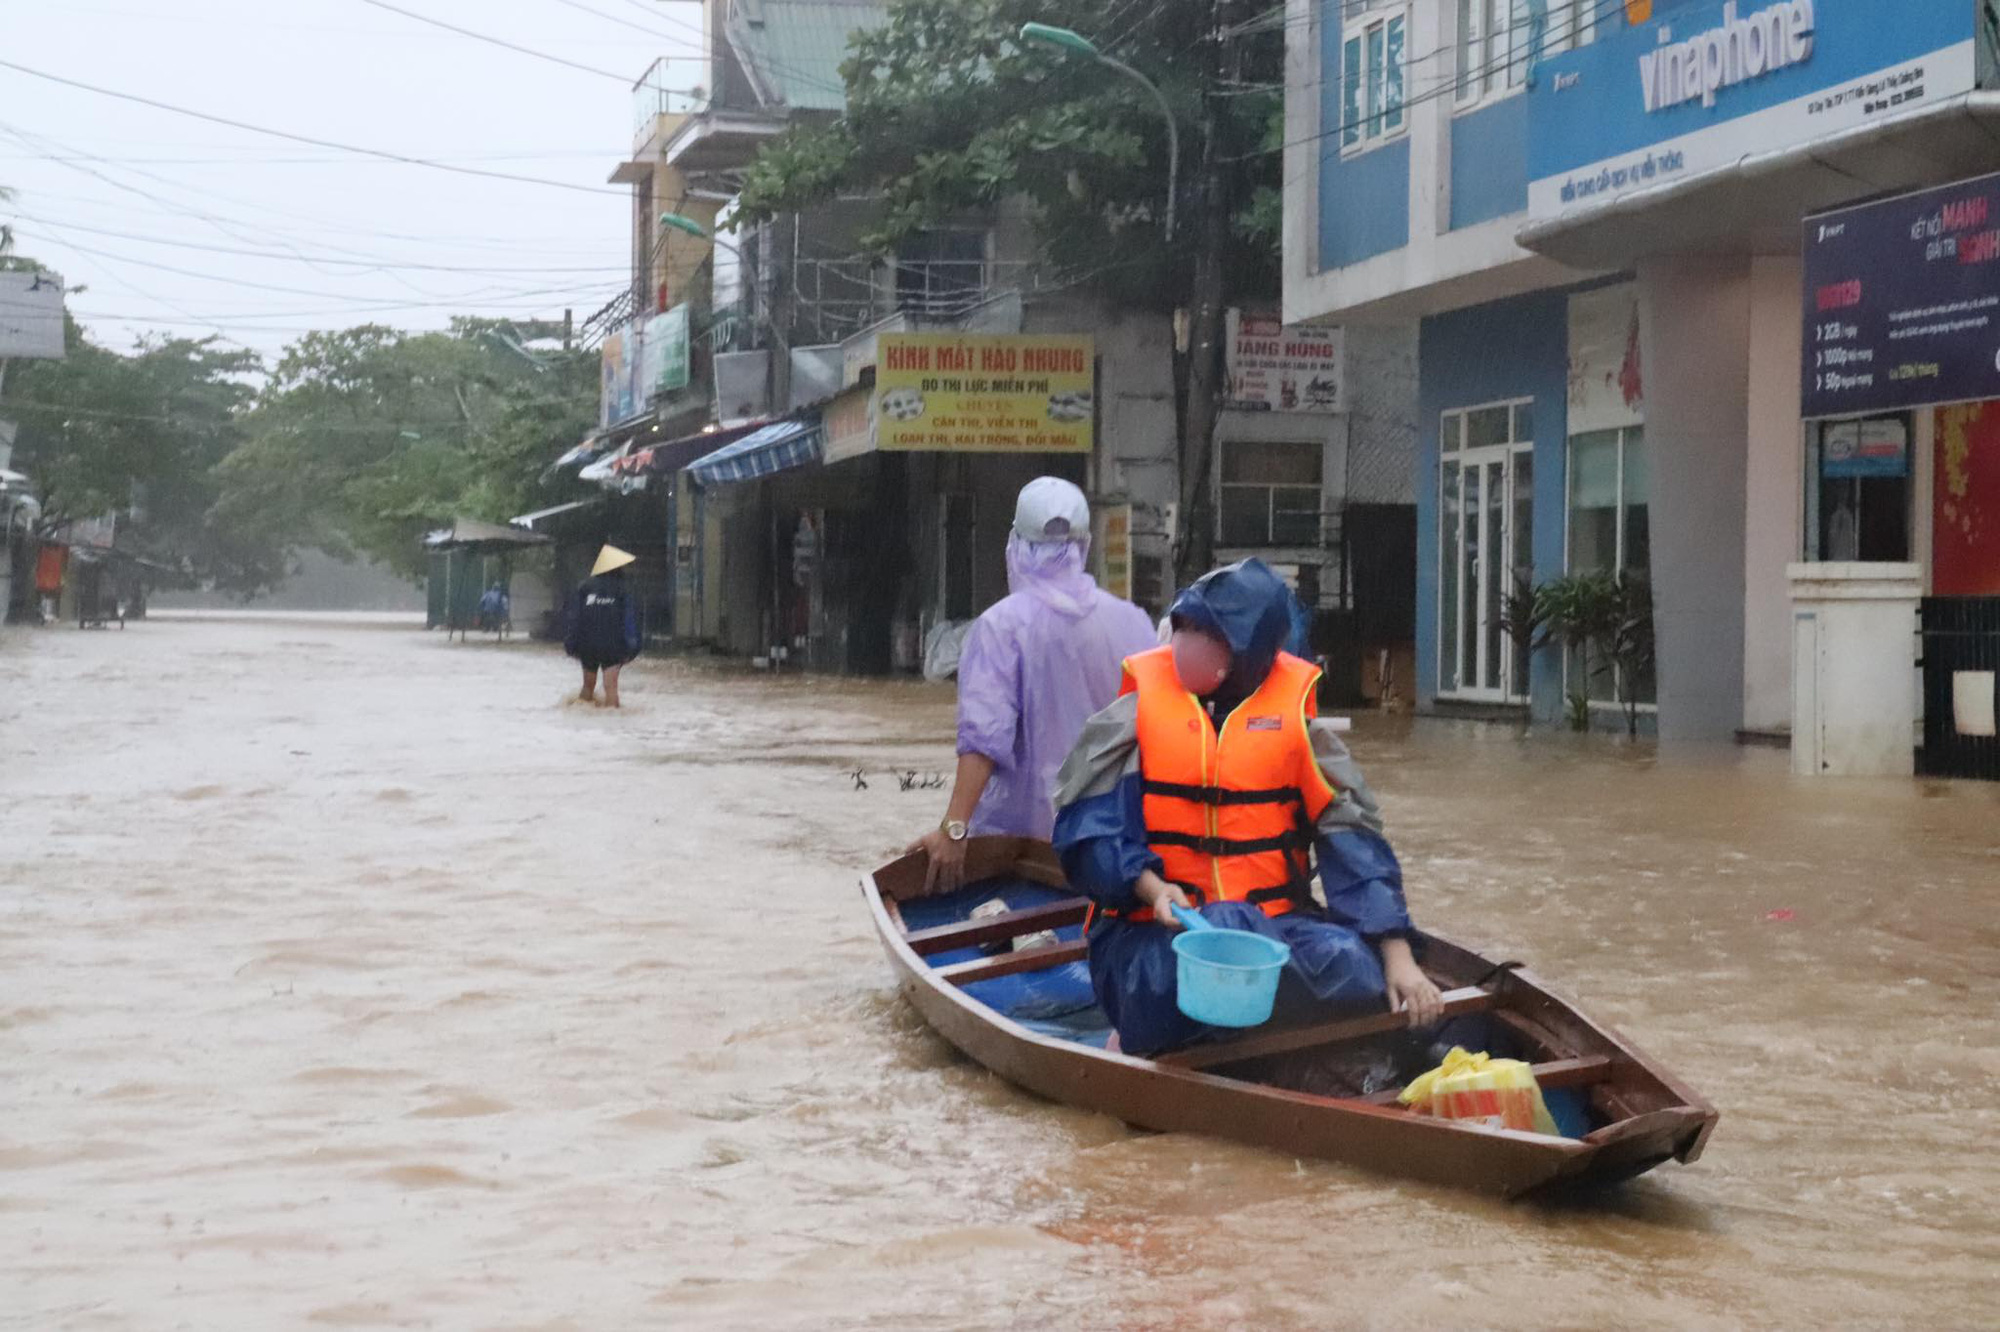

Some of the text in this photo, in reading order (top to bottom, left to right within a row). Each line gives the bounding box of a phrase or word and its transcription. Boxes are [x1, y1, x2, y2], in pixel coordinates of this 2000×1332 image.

[1639, 0, 1813, 112] vinaphone
[887, 339, 929, 370] KÍNH
[1023, 348, 1084, 373] NHUNG
